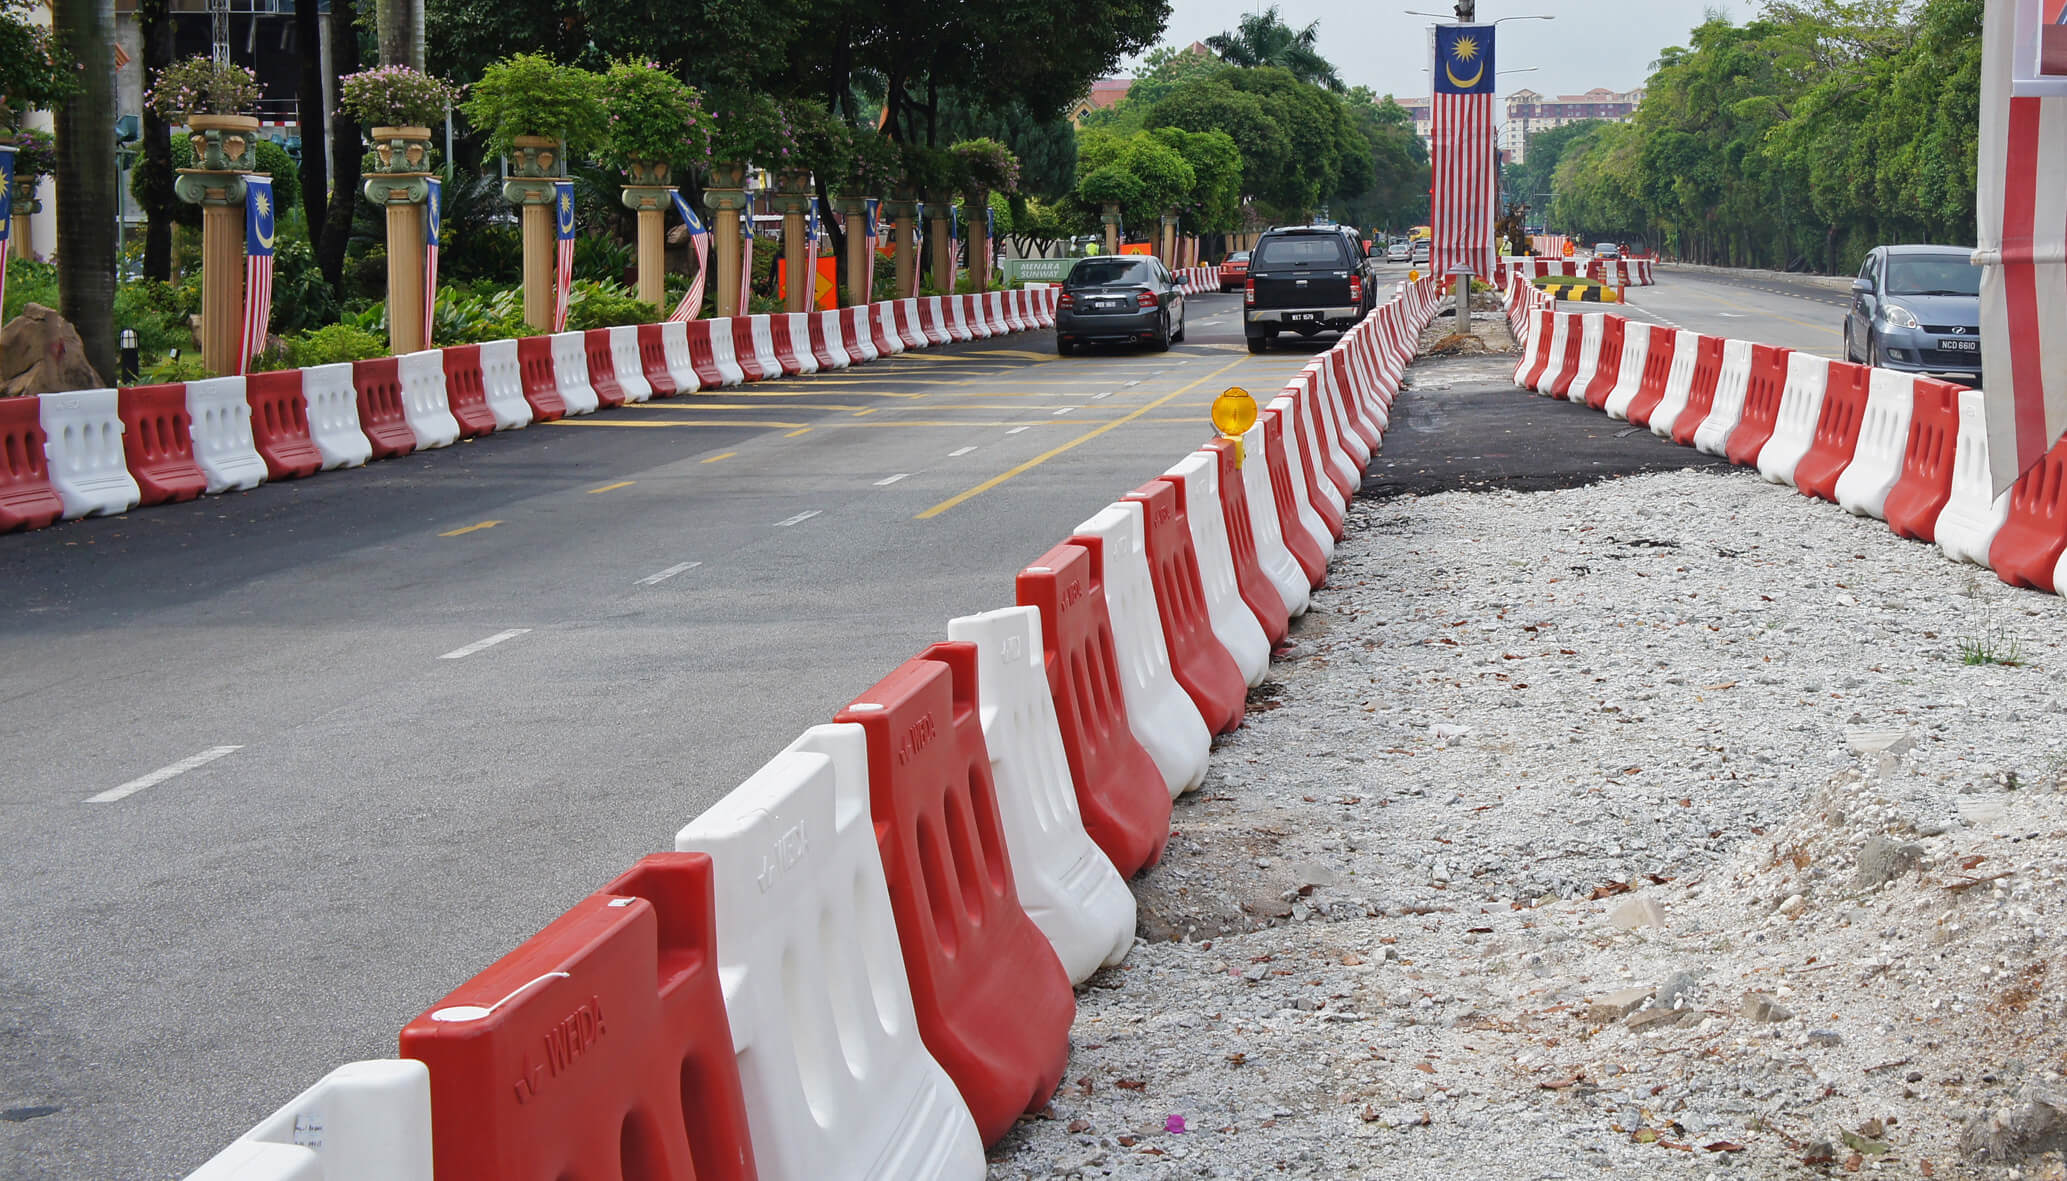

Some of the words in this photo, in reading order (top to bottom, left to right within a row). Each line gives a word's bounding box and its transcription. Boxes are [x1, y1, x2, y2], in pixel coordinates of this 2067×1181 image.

[1020, 263, 1060, 271] MENARA
[1020, 270, 1059, 278] SUNWAY
[1942, 340, 1957, 349] NCD
[544, 994, 607, 1078] WEIDA
